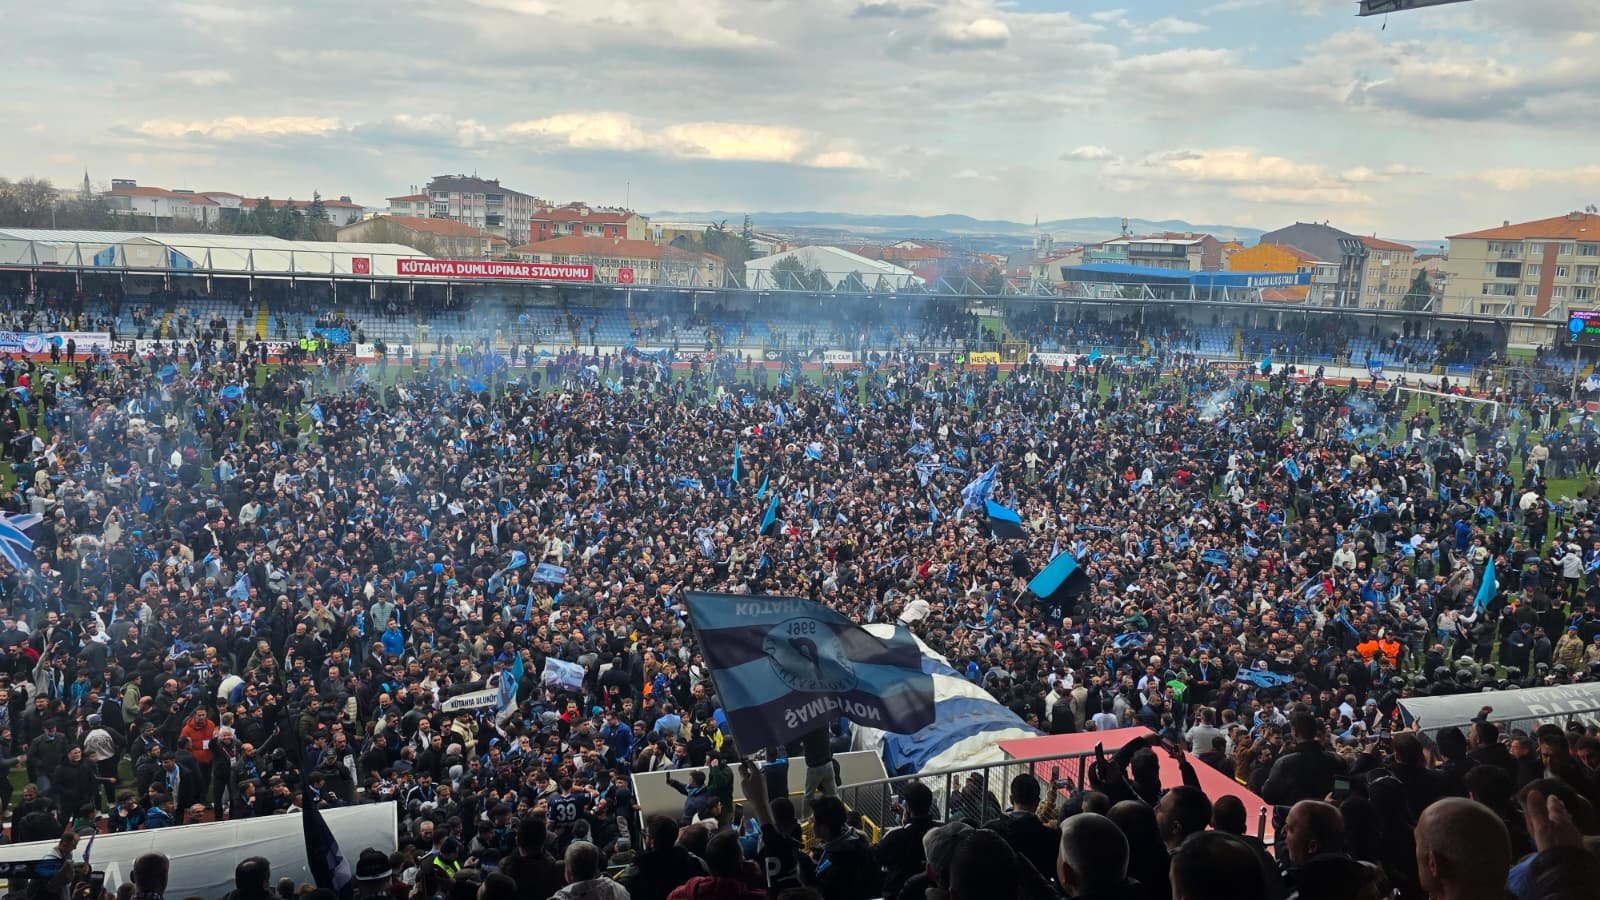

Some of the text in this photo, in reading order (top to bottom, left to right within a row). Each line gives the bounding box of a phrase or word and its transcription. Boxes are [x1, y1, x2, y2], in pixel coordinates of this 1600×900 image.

[401, 260, 589, 279] KÜTAHYA DUMLUPINAR STADYUMU
[451, 697, 475, 709] KÜTAHYA
[556, 802, 577, 822] 39
